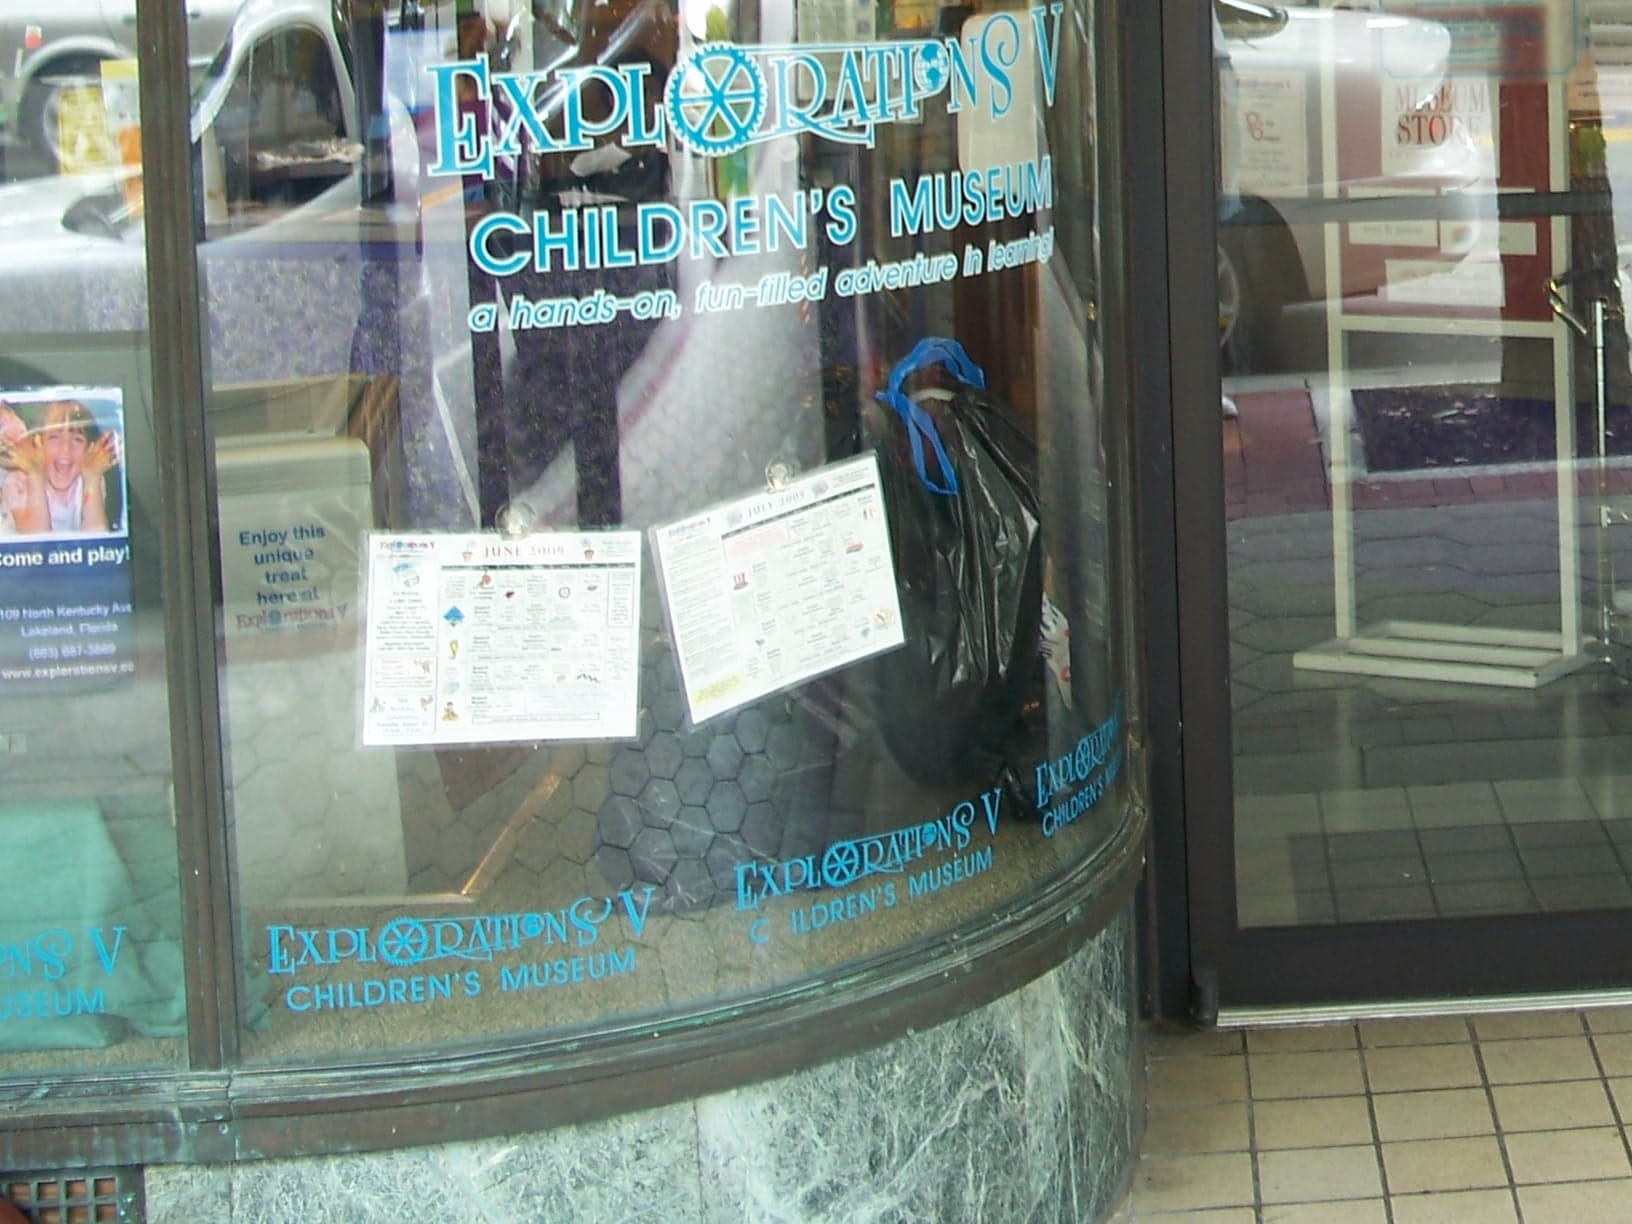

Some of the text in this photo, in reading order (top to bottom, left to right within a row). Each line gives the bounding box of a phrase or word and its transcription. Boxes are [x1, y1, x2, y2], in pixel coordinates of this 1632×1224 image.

[425, 2, 1065, 180] EXPLORATIONS V
[469, 156, 1051, 277] CHILDREN'S MUSEUM
[467, 226, 1054, 333] a hands-on, fun-filled adventure in learning!
[48, 547, 82, 565] and
[88, 545, 130, 566] play!
[239, 524, 326, 546] Enjoy this
[484, 546, 565, 558] JUNE 2009
[256, 586, 320, 606] here at
[265, 567, 308, 584] treat
[734, 787, 1002, 912] EXPLORATIONS V
[908, 847, 993, 903] MUSEUM
[87, 926, 127, 976] V
[266, 887, 655, 975] EXPLORATIONS V
[285, 948, 636, 1012] CHILDREN'S MUSEUM
